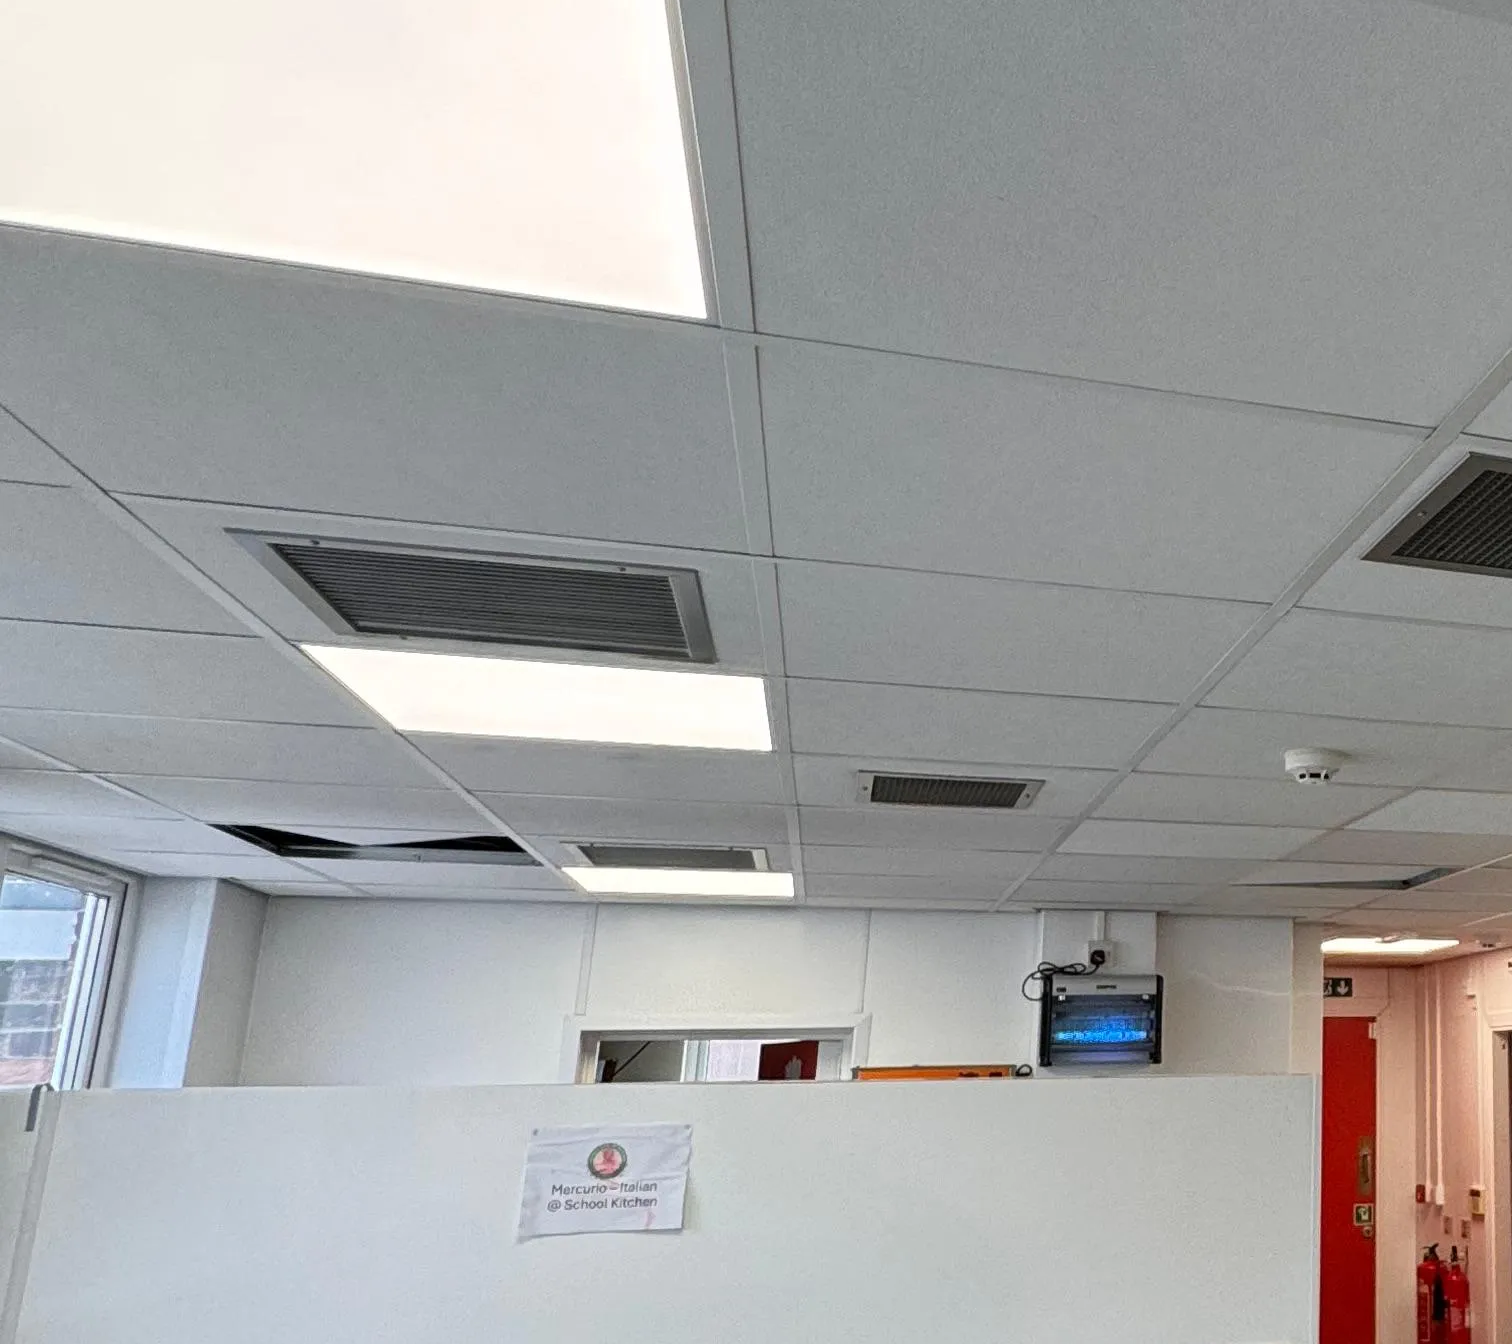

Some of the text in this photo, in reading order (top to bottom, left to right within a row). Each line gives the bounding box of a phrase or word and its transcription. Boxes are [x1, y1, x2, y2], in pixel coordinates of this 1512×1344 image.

[552, 1183, 606, 1196] Mercurio
[620, 1180, 658, 1194] Italian
[547, 1195, 658, 1212] @ School Kitchen
